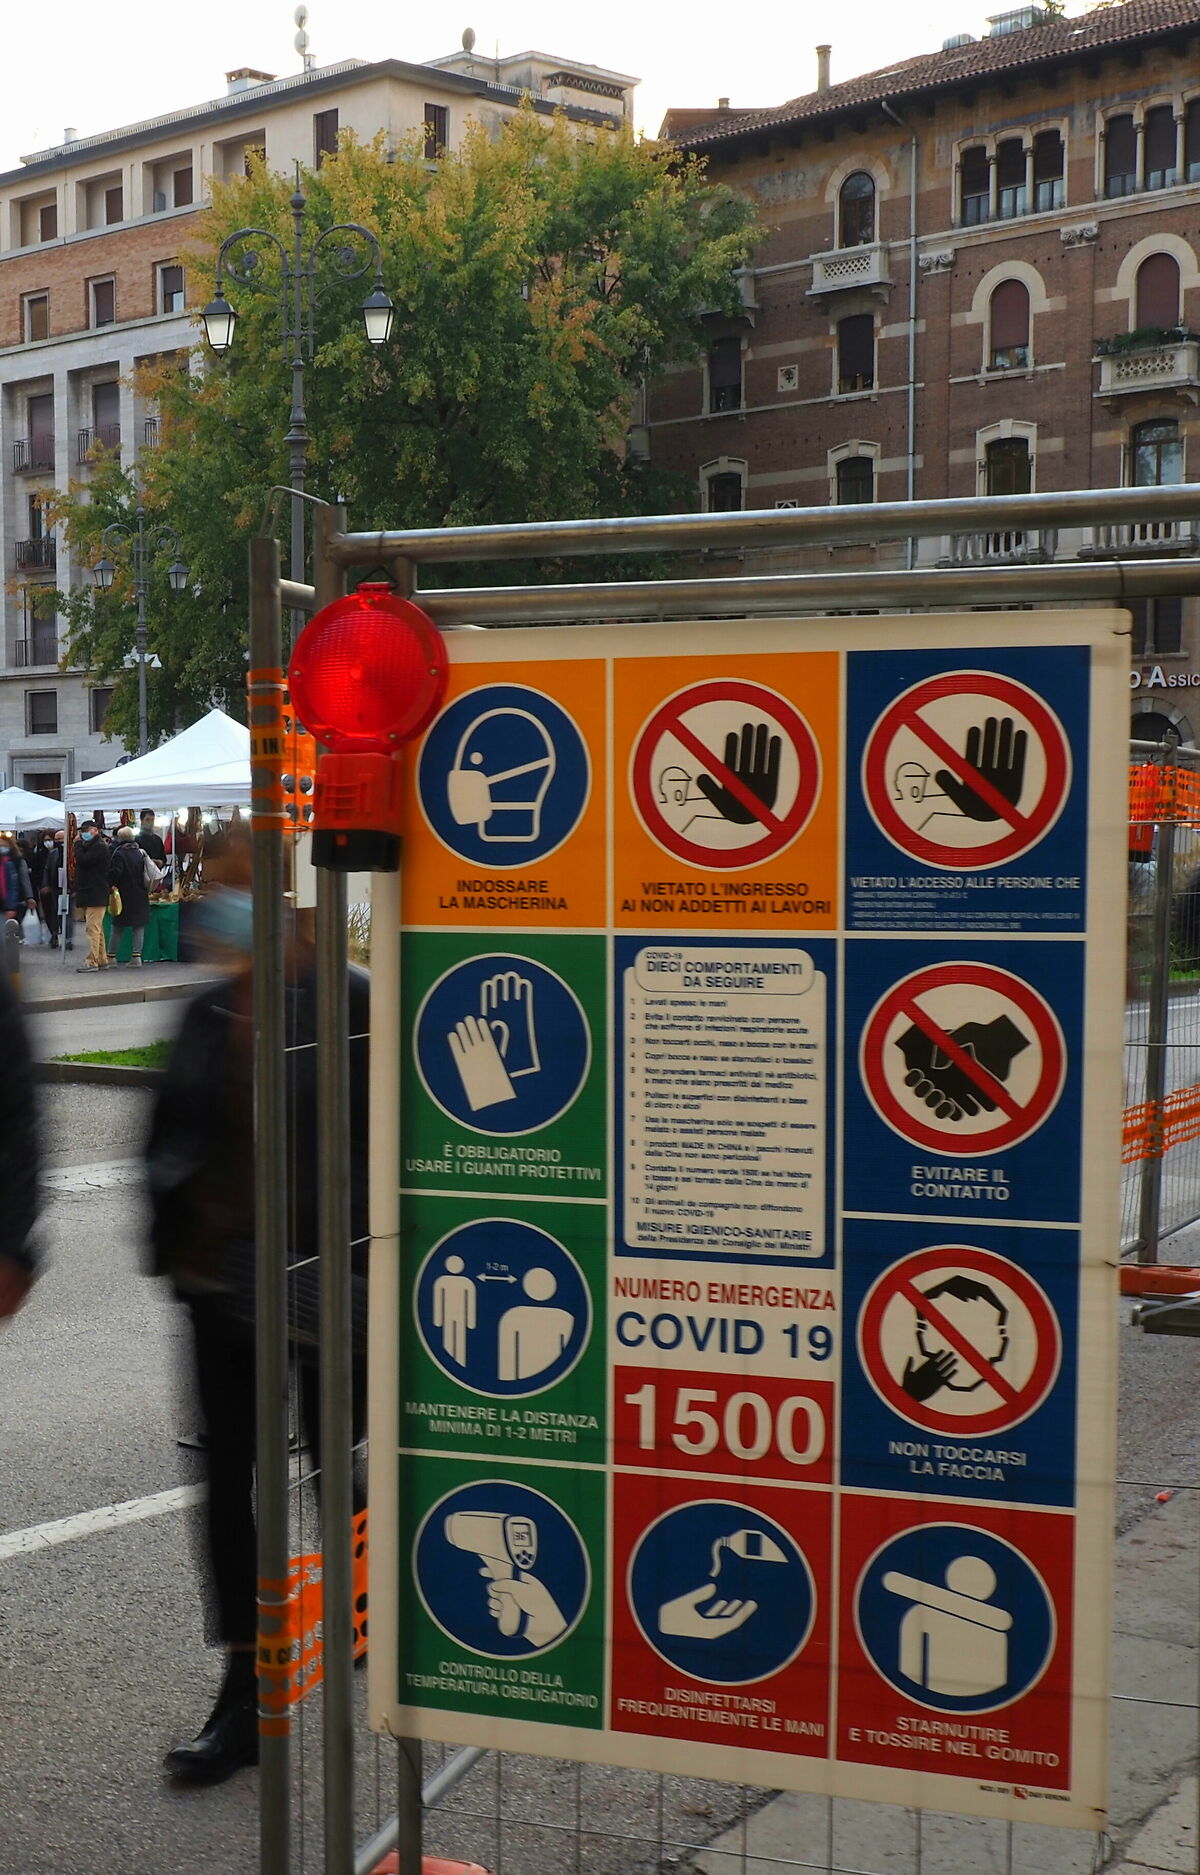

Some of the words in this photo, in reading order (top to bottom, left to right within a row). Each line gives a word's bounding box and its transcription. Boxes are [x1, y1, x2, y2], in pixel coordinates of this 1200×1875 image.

[457, 880, 549, 893] INDOSSARE
[642, 882, 706, 895] VIETATO
[711, 882, 809, 897] L'INGRESSO
[850, 877, 897, 888] VIETATO
[899, 877, 964, 888] L'ACCESSO
[965, 877, 995, 888] ALLE
[997, 877, 1053, 888] PERSONE
[1055, 877, 1081, 888] CHE
[439, 896, 460, 909] LA
[463, 896, 568, 910] MASCHERINA
[620, 899, 636, 912] AI
[641, 899, 674, 912] NON
[679, 900, 747, 913] ADDETTI
[751, 901, 766, 913] AI
[771, 900, 832, 914] LAVORI
[647, 961, 681, 973] DIECI
[685, 962, 802, 975] COMPORTAMENTI
[683, 976, 701, 987] DA
[706, 976, 764, 989] SEGUIRE
[443, 1141, 453, 1157] È
[456, 1144, 562, 1162] OBBLIGATORIO
[406, 1158, 452, 1173] USARE
[455, 1162, 460, 1174] I
[463, 1162, 515, 1177] GUANTI
[519, 1164, 601, 1180] PROTETTIVI
[911, 1166, 989, 1182] EVITARE
[992, 1169, 1010, 1183] IL
[910, 1183, 1010, 1200] CONTATTO
[637, 1221, 683, 1234] MISURE
[686, 1224, 812, 1241] IGIENICO-SANITARIE
[614, 1277, 701, 1302] NUMERO
[708, 1282, 836, 1311] EMERGENZA
[616, 1311, 764, 1355] COVID
[782, 1323, 834, 1361] 19
[405, 1402, 497, 1420] MANTENERE
[501, 1409, 521, 1423] LA
[524, 1411, 599, 1429] DISTANZA
[624, 1384, 826, 1465] 1500
[429, 1419, 482, 1436] MINIMA
[486, 1424, 500, 1437] DI
[506, 1427, 526, 1440] 1-2
[530, 1427, 577, 1443] METRI
[888, 1441, 929, 1457] NON
[932, 1445, 1027, 1466] TOCCARSI
[910, 1460, 934, 1474] LA
[938, 1463, 1005, 1481] FACCIA
[439, 1661, 519, 1683] CONTROLLO
[520, 1672, 563, 1688] DELLA
[406, 1673, 499, 1696] TEMPERATURA
[501, 1684, 599, 1709] OBBLIGATORIO
[664, 1687, 776, 1714] DISINFETTARSI
[618, 1698, 759, 1728] FREQUENTEMENTE
[762, 1716, 782, 1732] LE
[785, 1719, 824, 1737] MANI
[896, 1716, 1010, 1743] STARNUTIRE
[849, 1728, 861, 1741] E
[865, 1730, 942, 1752] TOSSIRE
[946, 1740, 983, 1758] NEL
[985, 1745, 1060, 1767] GOMITO
